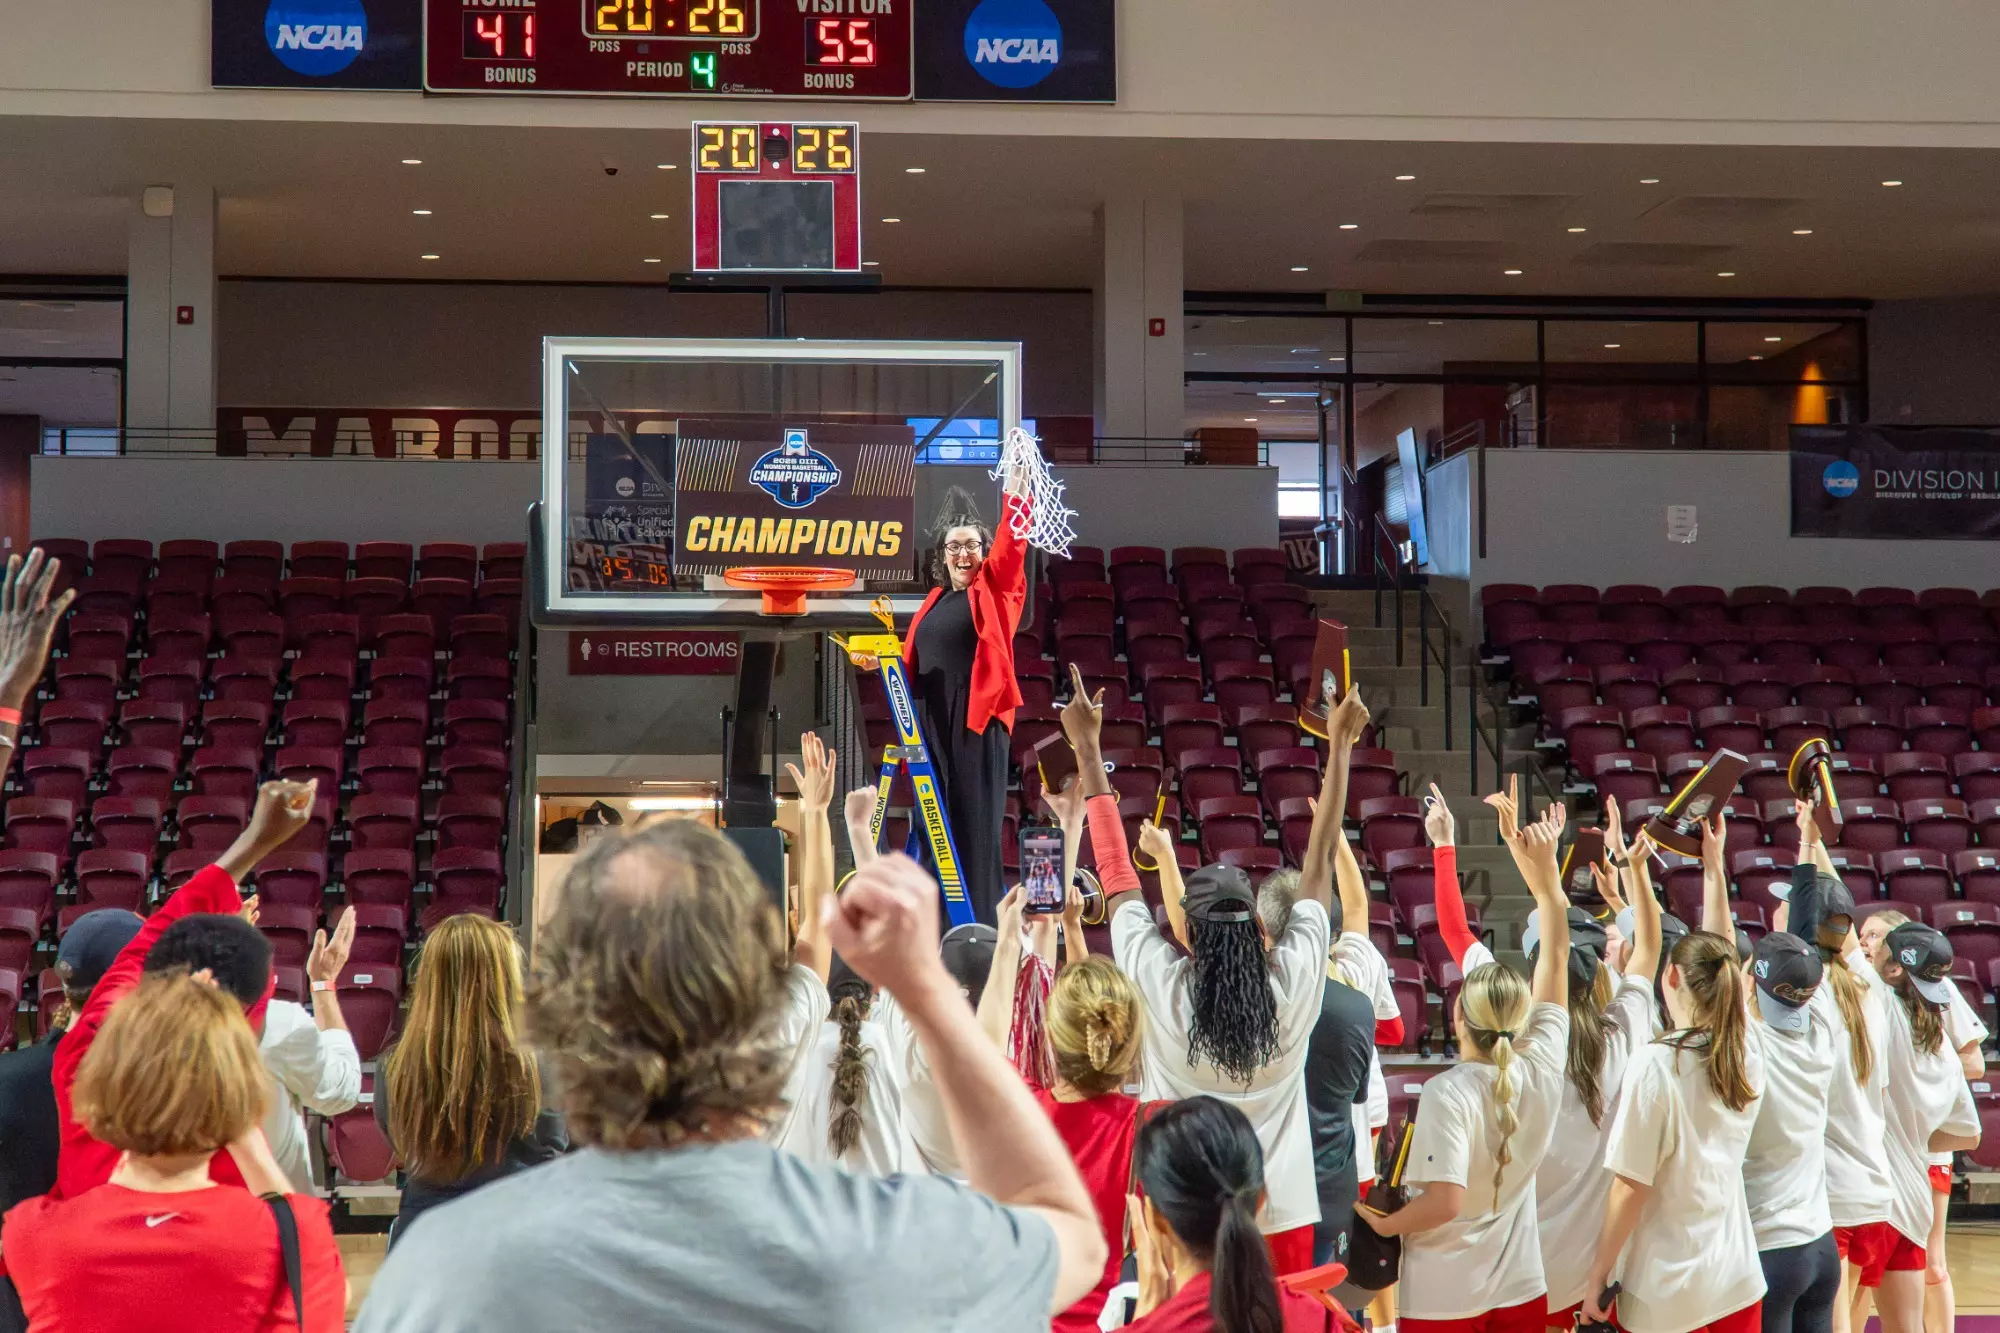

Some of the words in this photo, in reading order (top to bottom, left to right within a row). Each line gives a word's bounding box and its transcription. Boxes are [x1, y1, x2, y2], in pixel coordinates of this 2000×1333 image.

[275, 24, 363, 51] NCAA
[477, 14, 533, 57] 41
[819, 20, 874, 63] 55
[589, 40, 621, 52] POSS
[721, 43, 752, 55] POSS
[975, 38, 1059, 64] NCAA
[484, 67, 537, 83] BONUS
[626, 61, 684, 78] PERIOD
[693, 54, 714, 88] 4
[803, 73, 855, 89] BONUS
[752, 470, 838, 484] CHAMPIONSHIP
[791, 464, 828, 472] BASKETBALL
[1875, 469, 1984, 490] DIVISION
[637, 505, 671, 516] Special
[637, 517, 674, 527] Unified
[685, 515, 903, 556] CHAMPIONS
[614, 641, 738, 658] RESTROOMS
[891, 679, 910, 724] WERNER
[870, 796, 886, 835] PODIUM
[922, 798, 951, 863] BASKETBALL
